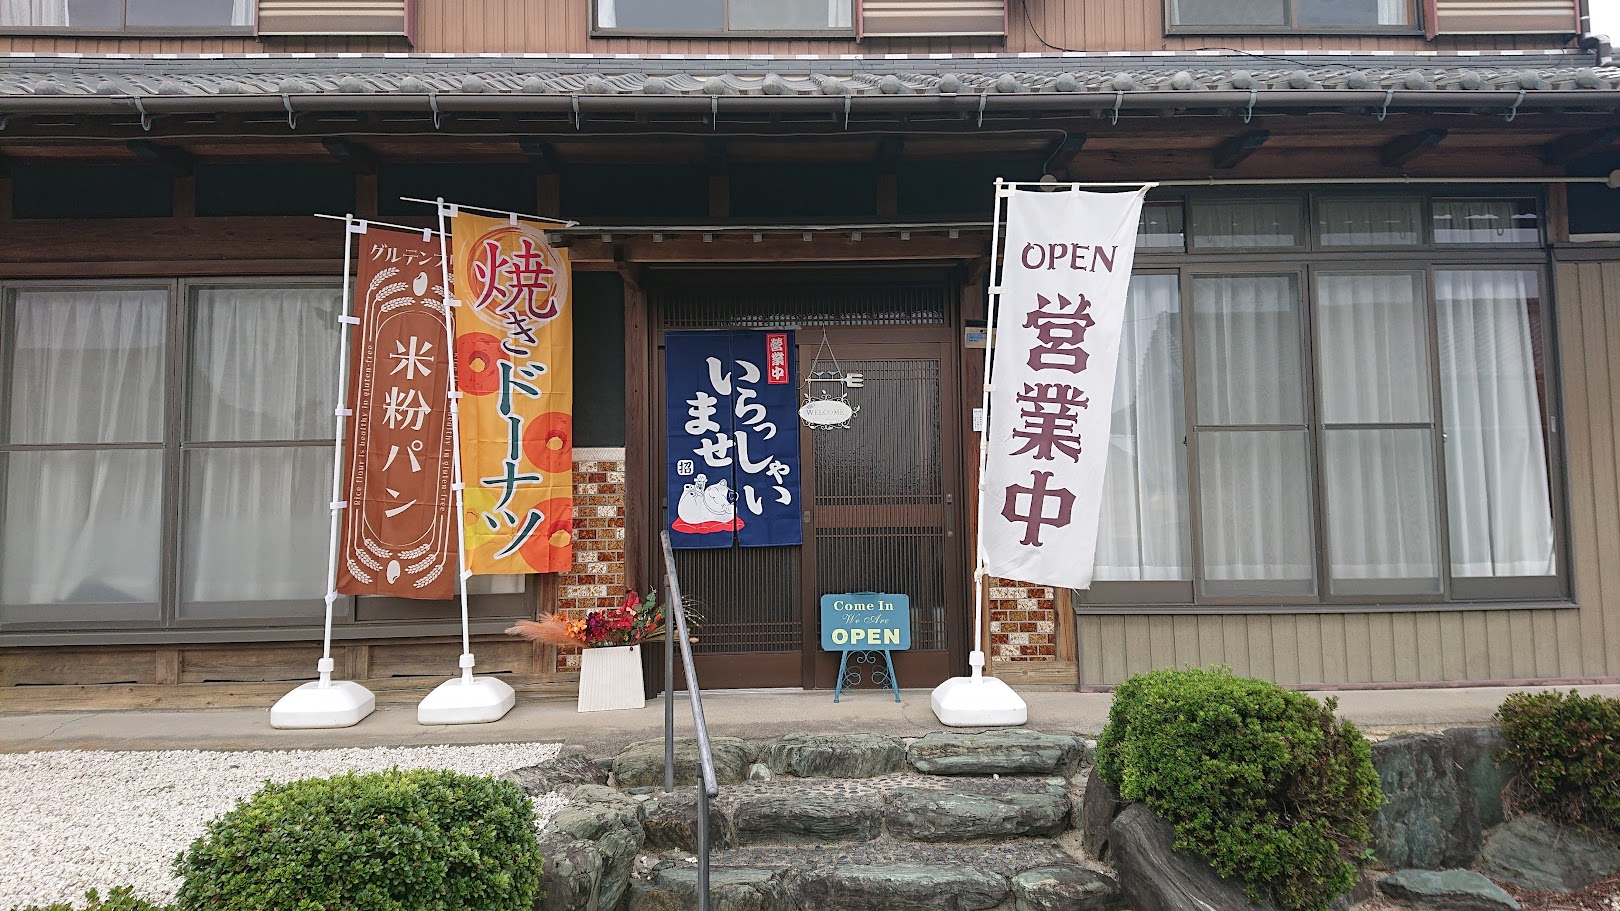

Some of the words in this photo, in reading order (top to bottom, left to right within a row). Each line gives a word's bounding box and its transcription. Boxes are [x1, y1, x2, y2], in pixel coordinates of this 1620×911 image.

[1021, 241, 1118, 273] OPEN
[363, 345, 373, 397] gluten-free
[361, 400, 369, 409] in
[474, 238, 561, 559] 焼きドーナツ
[806, 409, 845, 417] WELCOME
[1000, 293, 1096, 548] 営業中
[359, 412, 369, 447] healthy
[382, 336, 435, 518] 米粉パン
[684, 391, 736, 467] ませ
[706, 356, 792, 516] いらっしゃい
[358, 449, 366, 458] is
[443, 449, 451, 458] in
[355, 461, 365, 483] flour
[679, 461, 692, 474] 招
[353, 486, 362, 506] Rice
[440, 461, 451, 512] gluten-free
[833, 600, 874, 611] Come
[878, 600, 894, 611] In
[842, 613, 860, 624] We
[864, 613, 890, 624] Are
[831, 628, 900, 645] OPEN
